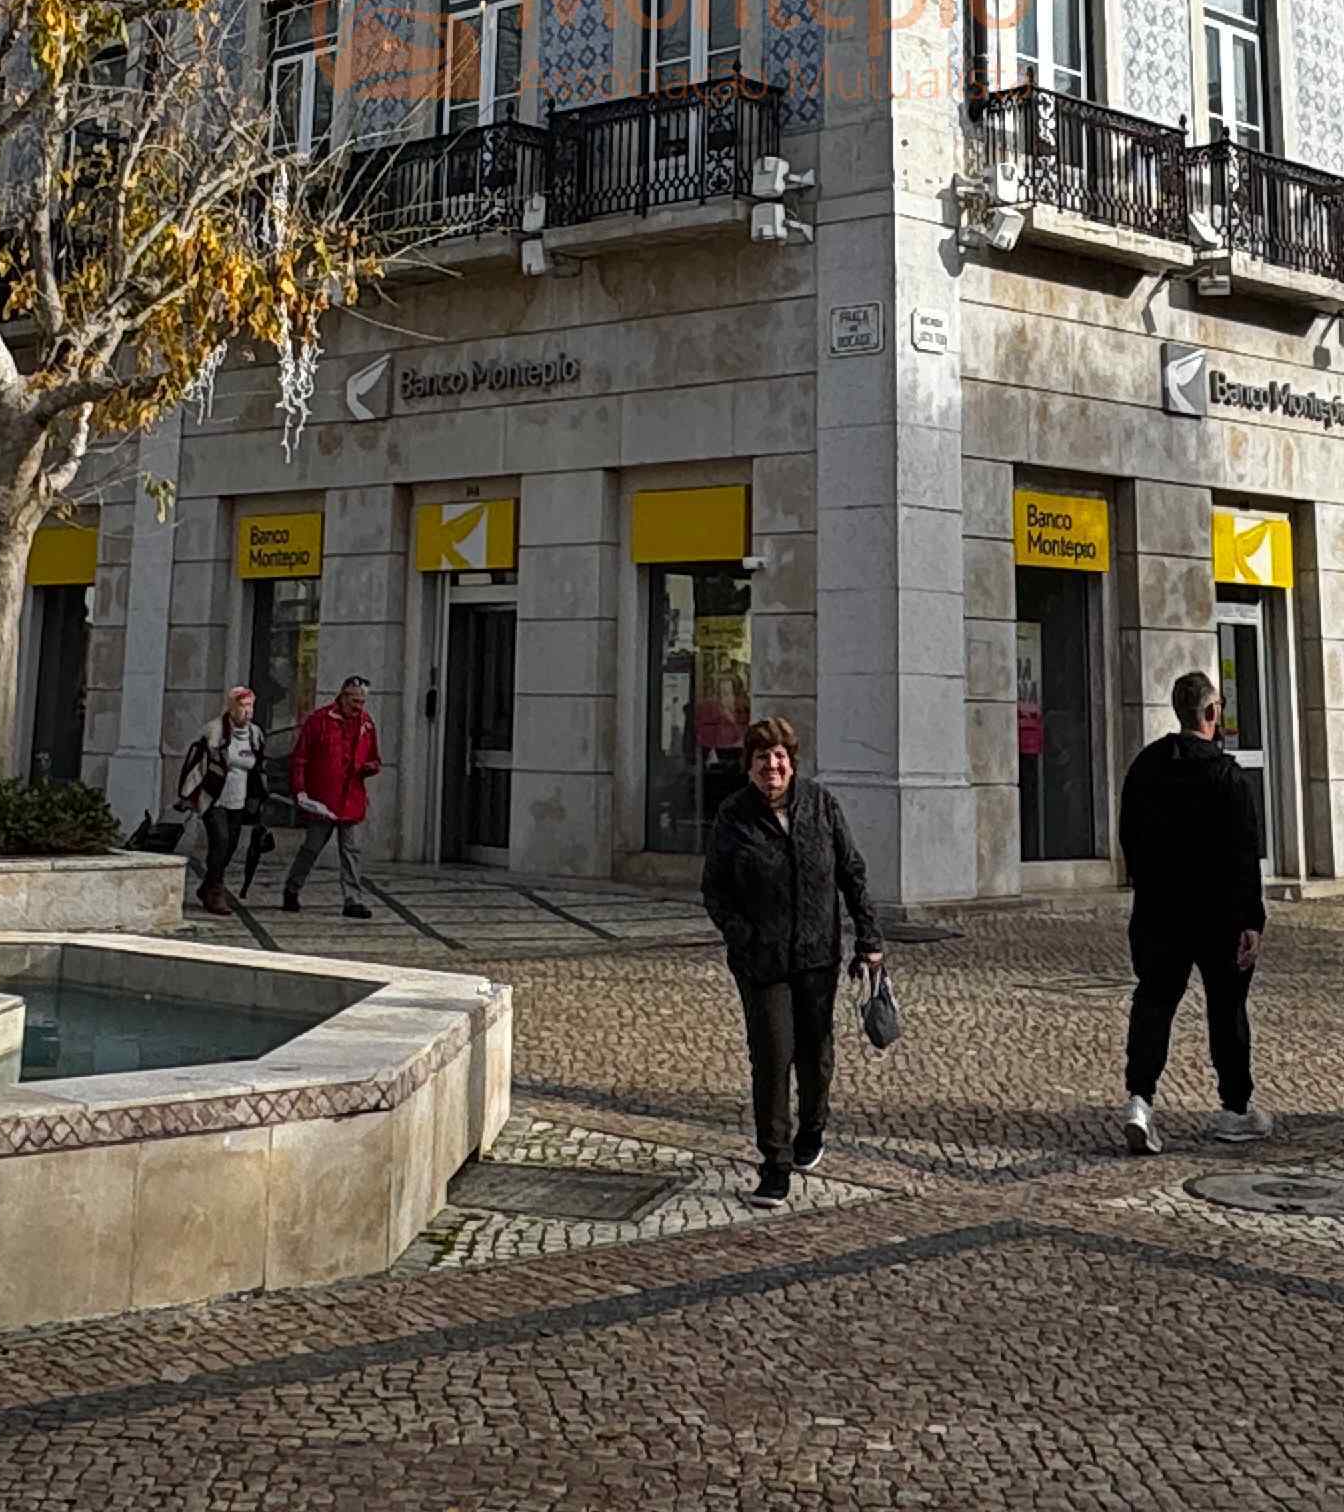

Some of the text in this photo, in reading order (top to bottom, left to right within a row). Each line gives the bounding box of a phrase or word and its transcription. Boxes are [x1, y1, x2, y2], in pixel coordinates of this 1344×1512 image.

[400, 353, 580, 400] Banco Montepio
[1209, 369, 1270, 411] Banco
[1026, 503, 1072, 530] Banco
[250, 525, 289, 545] Banco
[1026, 530, 1096, 564] Montepio
[249, 548, 310, 570] Montepio
